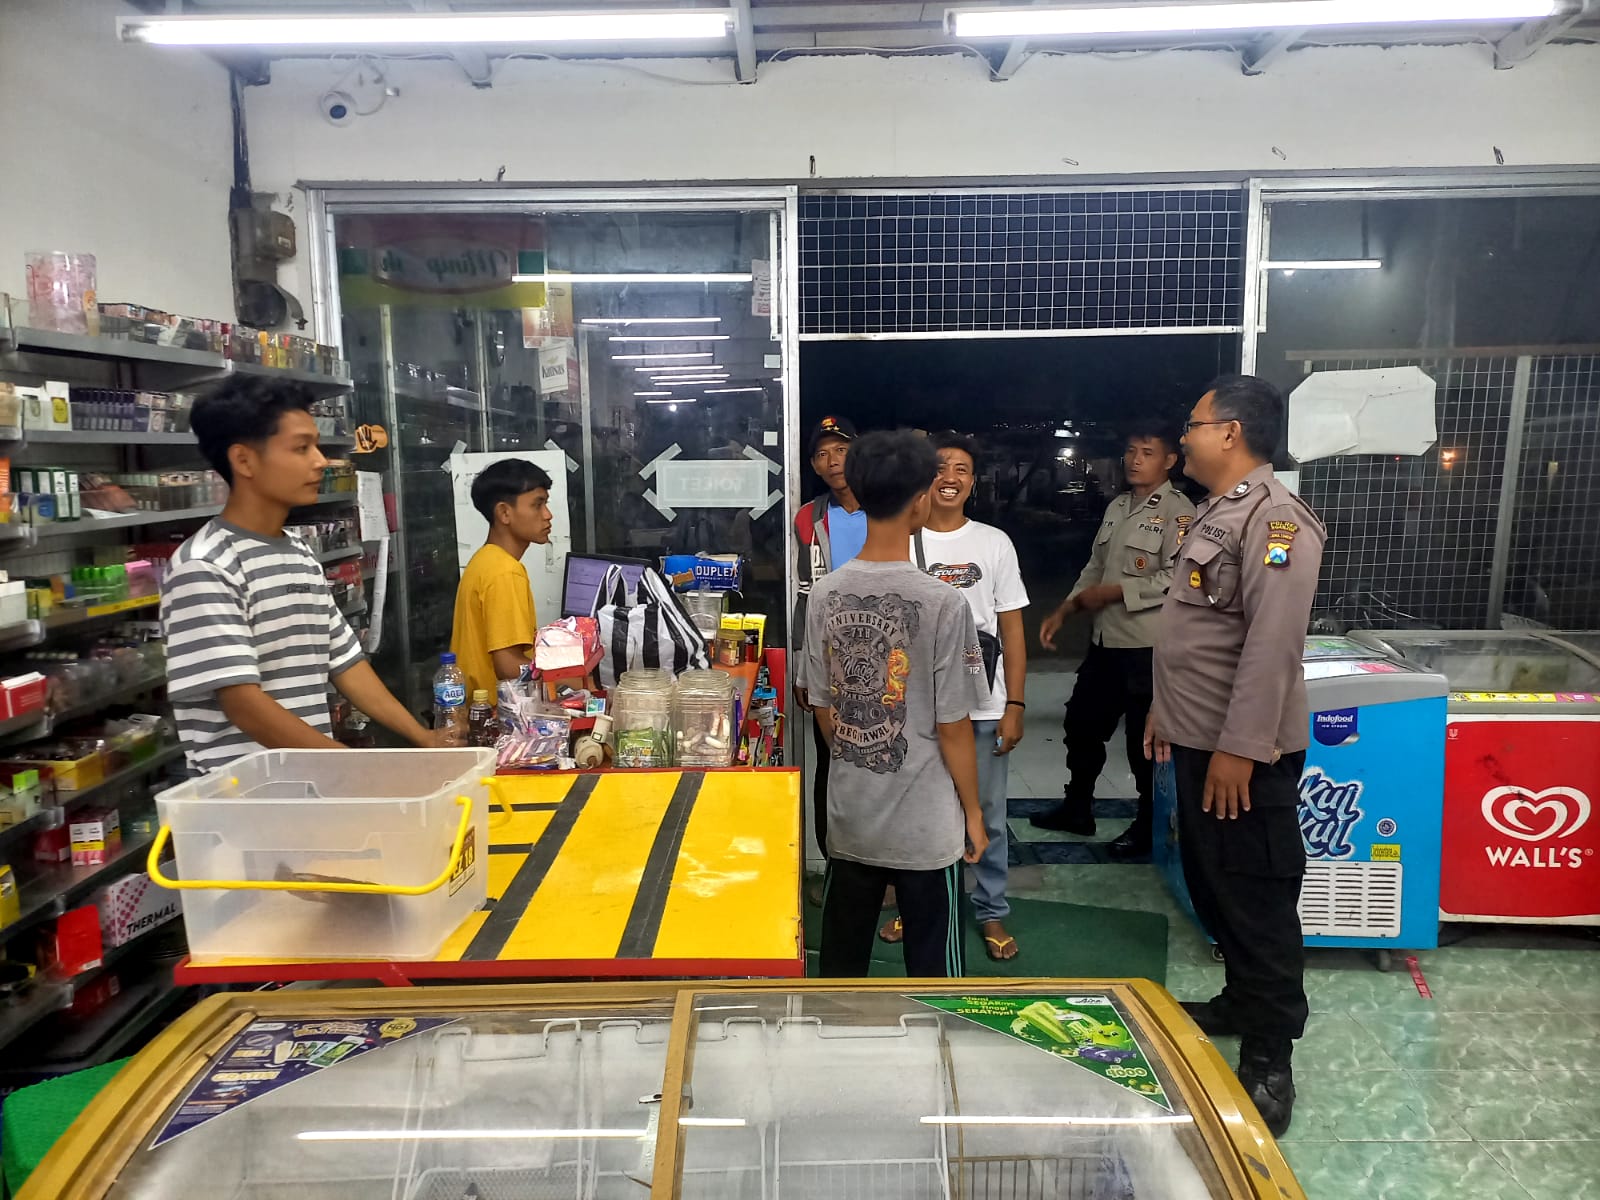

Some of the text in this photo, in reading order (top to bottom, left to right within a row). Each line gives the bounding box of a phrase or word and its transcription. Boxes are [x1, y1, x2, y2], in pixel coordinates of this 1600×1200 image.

[1138, 523, 1164, 535] POLRI
[1200, 523, 1226, 540] POLISI
[1316, 714, 1354, 725] Indofood
[1299, 773, 1360, 823] Kul
[1485, 845, 1583, 869] WALL'S
[126, 903, 176, 936] THERMAL
